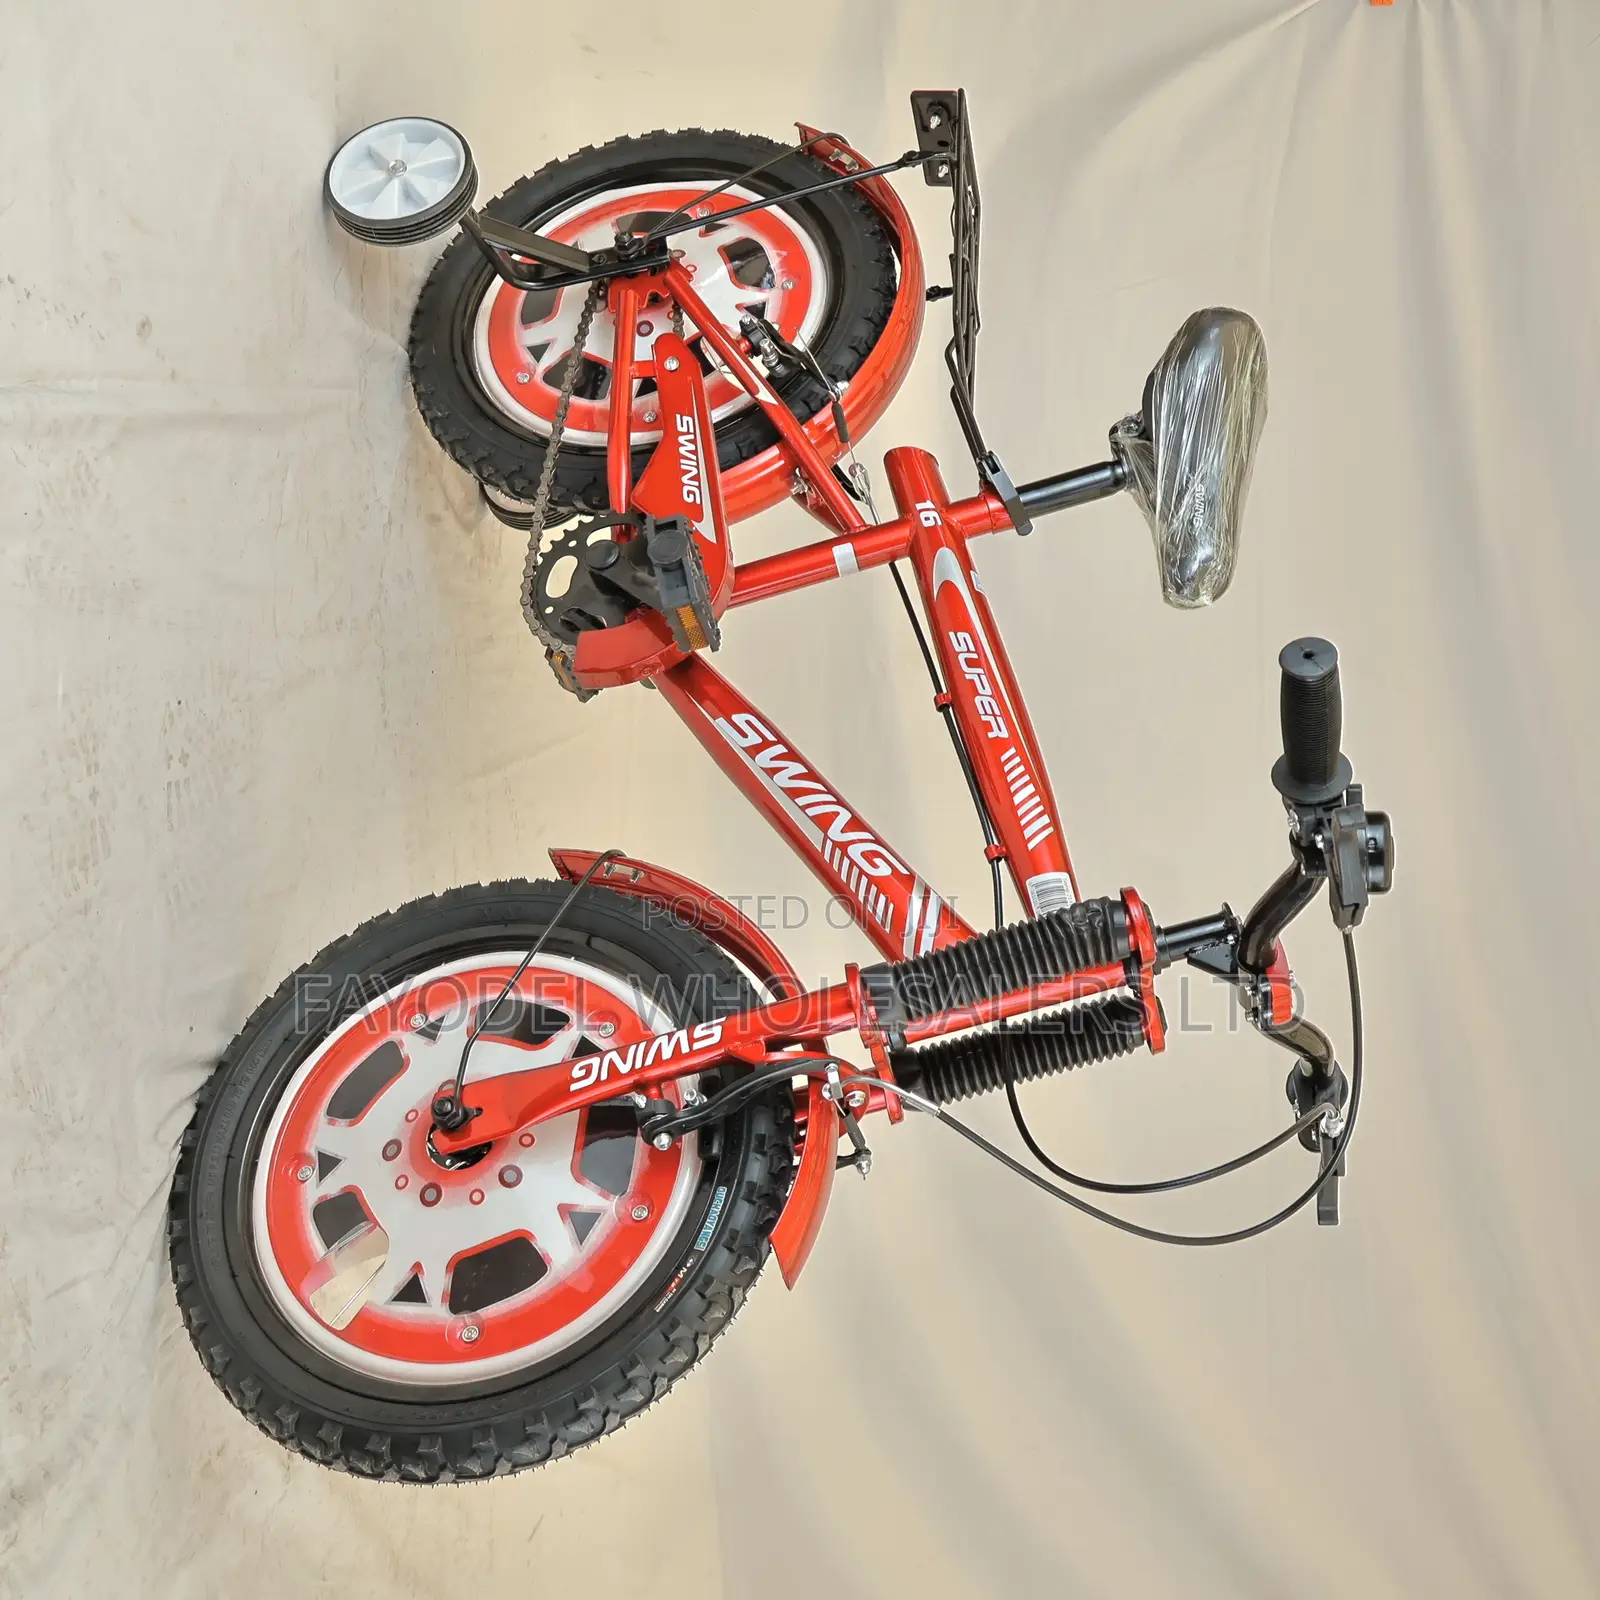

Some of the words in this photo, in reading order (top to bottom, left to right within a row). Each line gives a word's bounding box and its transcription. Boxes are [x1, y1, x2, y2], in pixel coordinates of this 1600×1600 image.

[675, 413, 702, 505] SWING
[914, 499, 943, 528] 16
[949, 631, 1010, 740] SUPER
[715, 712, 911, 877] SWING
[570, 1015, 728, 1092] SWING
